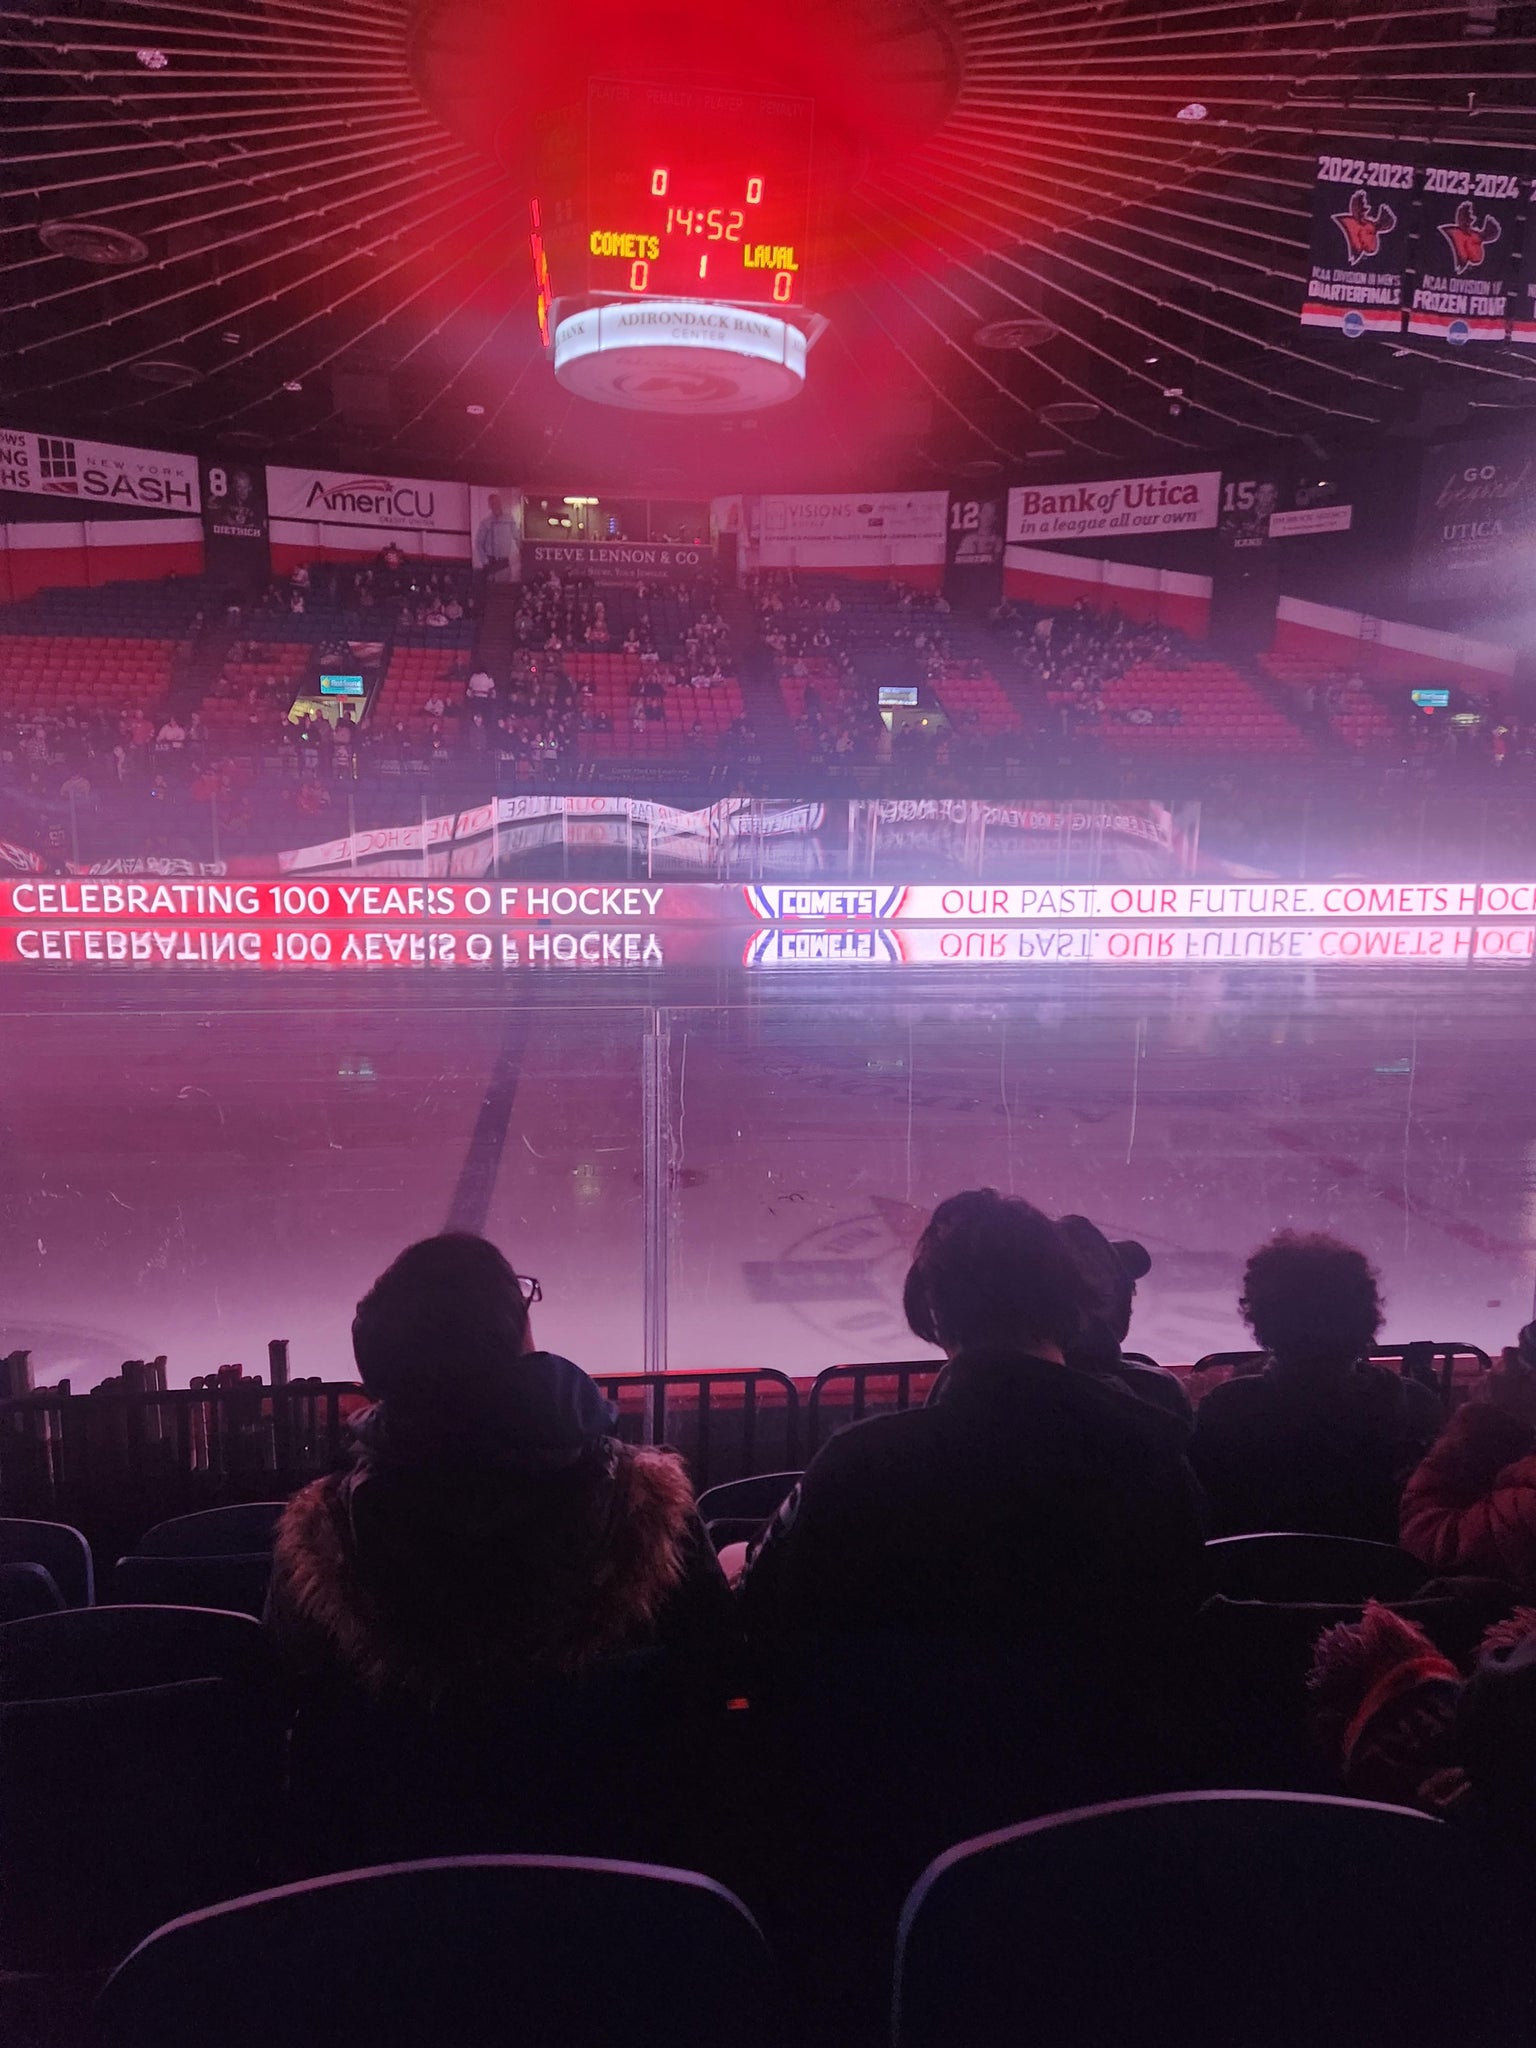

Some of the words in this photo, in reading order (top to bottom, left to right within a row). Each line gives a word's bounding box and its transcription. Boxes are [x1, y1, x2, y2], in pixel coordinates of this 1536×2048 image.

[652, 169, 667, 196] 0
[1317, 156, 1414, 189] 2022-2023
[1424, 168, 1520, 199] 2023-2024
[747, 178, 762, 204] 0
[667, 208, 743, 241] 14:52
[590, 231, 660, 259] COMETS
[744, 244, 799, 271] LAVAL
[630, 260, 648, 291] 0
[700, 254, 707, 278] 1
[773, 271, 792, 301] 0
[1308, 280, 1401, 306] QUARTERFINALS
[1422, 274, 1447, 290] NCAA
[1450, 277, 1490, 295] DIVISION
[1413, 289, 1467, 315] FROZEN
[1469, 297, 1507, 317] FOUR
[618, 311, 729, 330] ADIRONDACK
[734, 319, 771, 339] BANK
[671, 328, 726, 342] CENTER
[86, 456, 125, 471] NEW
[136, 464, 185, 478] YORK
[1464, 465, 1496, 482] GO
[83, 469, 192, 507] SASH
[209, 467, 227, 497] 8
[306, 480, 434, 519] AmeriCU
[1022, 488, 1098, 516] Bank
[1097, 487, 1121, 514] of
[1123, 480, 1199, 509] Utica
[1222, 481, 1256, 512] 15
[789, 503, 851, 518] VISIONS
[950, 500, 980, 530] 12
[1020, 518, 1036, 535] in
[1039, 523, 1049, 533] a
[1053, 517, 1105, 534] league
[1109, 513, 1130, 529] all
[1133, 514, 1160, 526] our
[1163, 511, 1197, 524] own
[213, 524, 261, 538] DIETRICH
[1443, 519, 1503, 541] UTICA
[534, 547, 584, 562] STEVE
[589, 548, 655, 564] LENNON
[661, 551, 670, 564] &
[675, 551, 699, 565] CO
[12, 883, 261, 914] CELEBRATING
[269, 886, 330, 914] 100
[338, 886, 455, 915] YEARS
[527, 887, 663, 916] HOCKEY
[782, 890, 873, 914] COMETS
[942, 889, 1009, 914] OUR
[1021, 889, 1101, 913] PAST.
[1111, 888, 1178, 913] OUR
[1189, 888, 1314, 913] FUTURE.
[1324, 887, 1448, 912] COMETS
